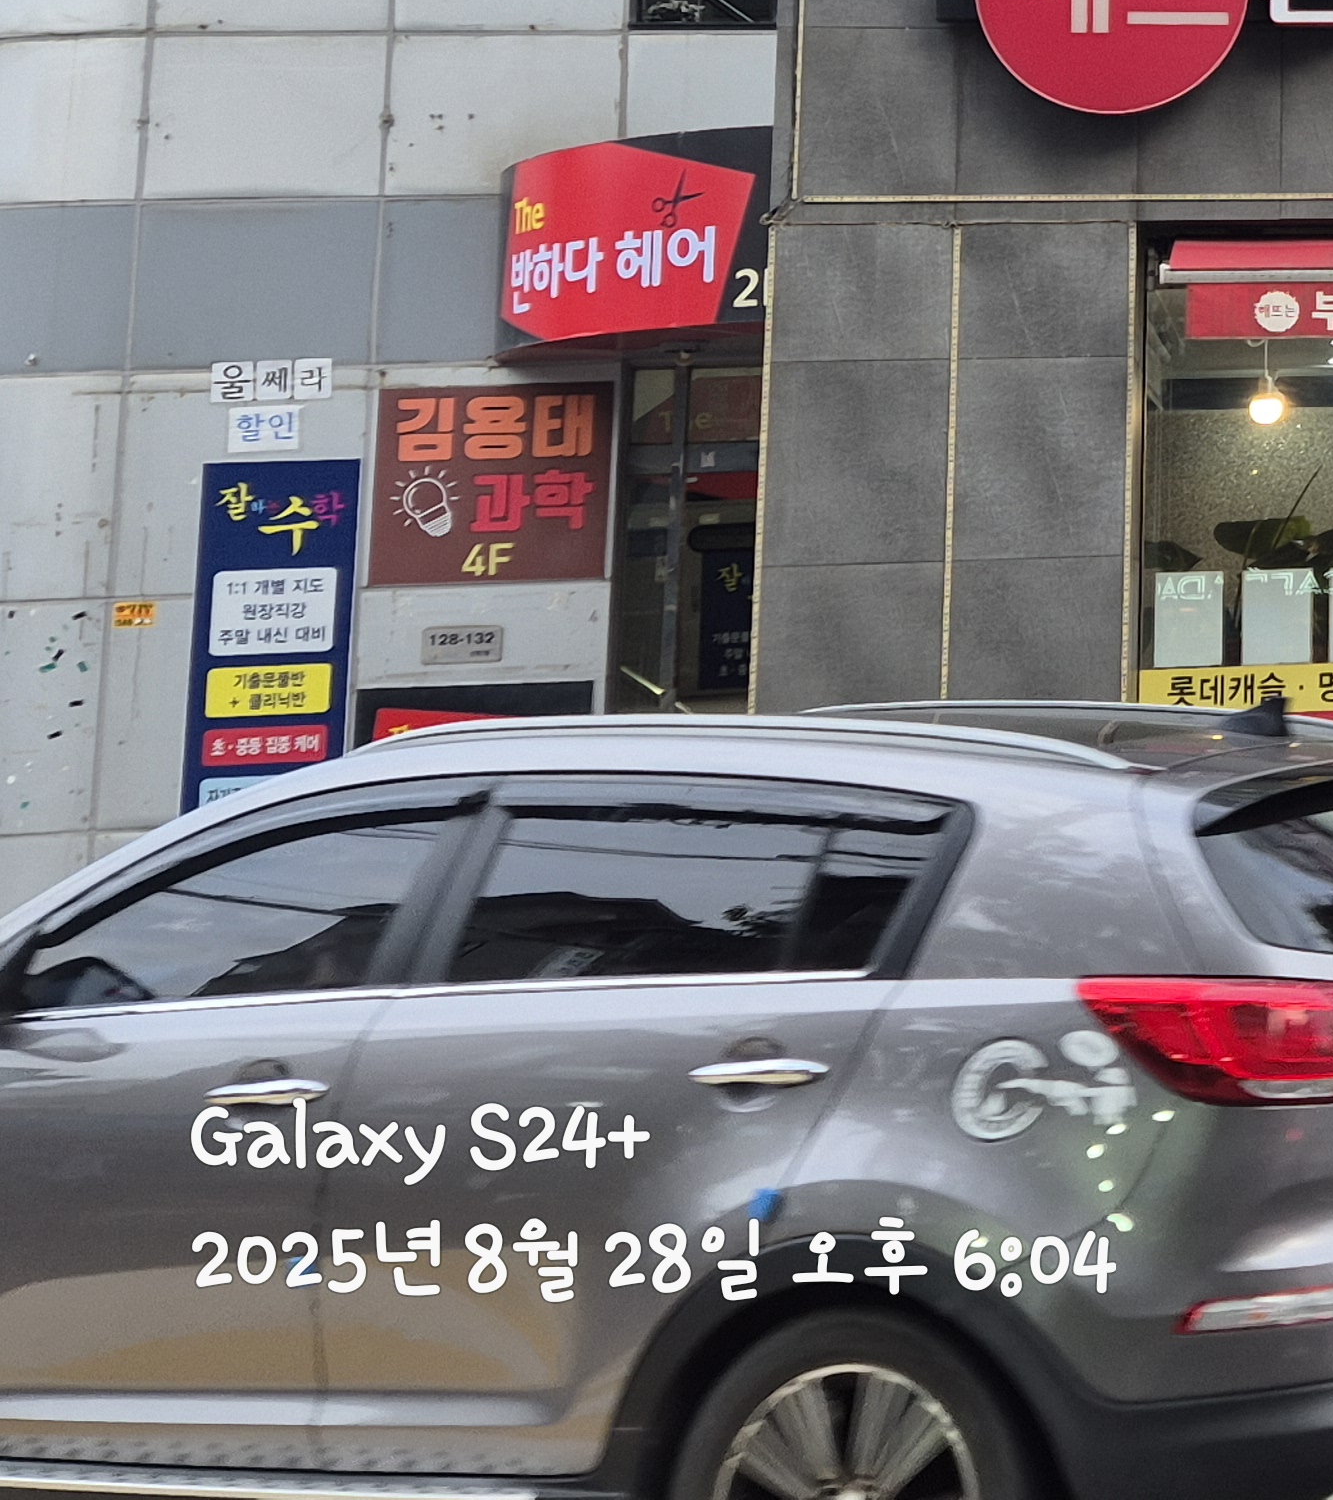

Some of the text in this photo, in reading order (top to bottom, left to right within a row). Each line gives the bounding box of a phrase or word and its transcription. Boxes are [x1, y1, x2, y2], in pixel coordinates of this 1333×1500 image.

[513, 196, 547, 235] The
[510, 225, 717, 315] 반하다 헤어
[234, 411, 295, 442] 할인
[396, 394, 596, 462] 김용태
[468, 468, 596, 534] 과학
[460, 541, 517, 577] 4F
[226, 578, 325, 596] 1:1 개별 지도
[241, 602, 307, 621] 원장직강
[217, 626, 327, 646] 주말 내신 대비
[428, 631, 496, 647] 128-132
[1166, 674, 1287, 706] 롯데캐슬
